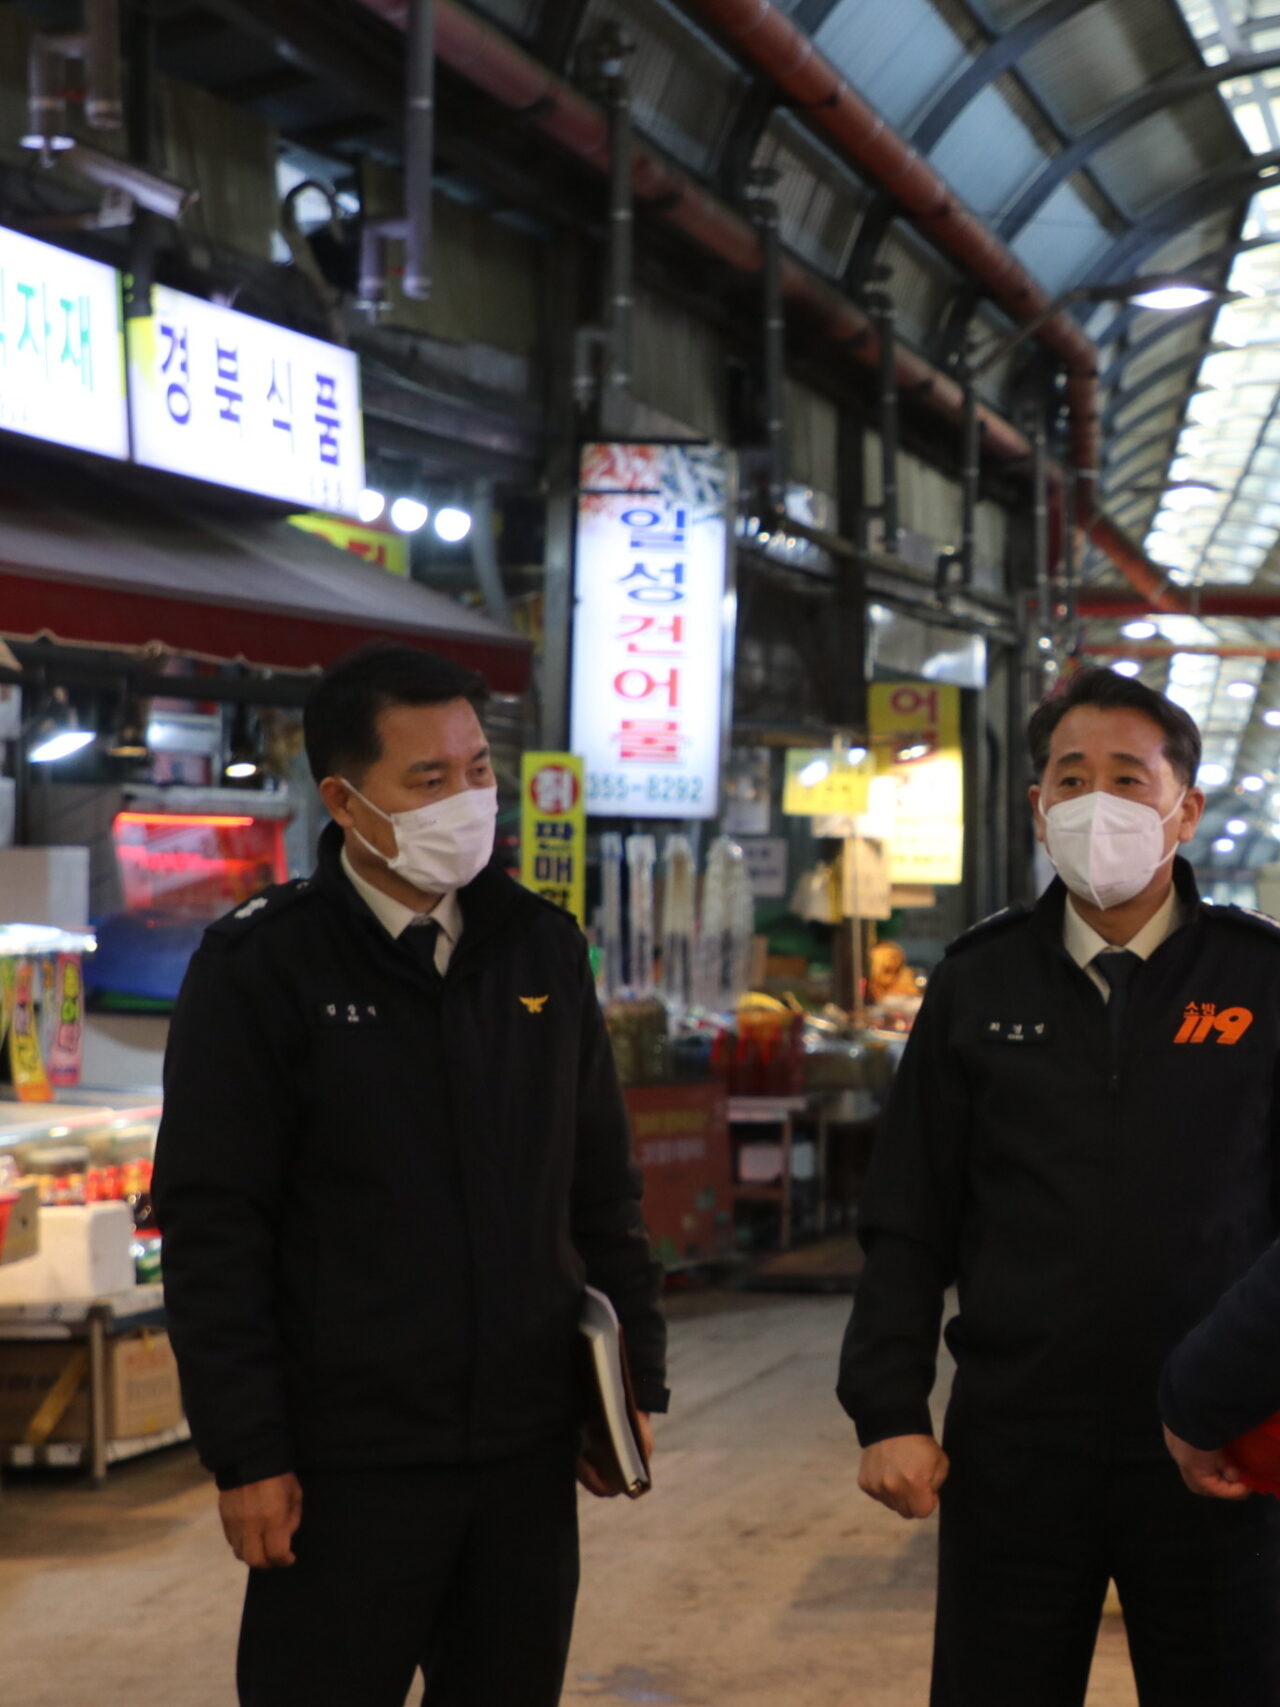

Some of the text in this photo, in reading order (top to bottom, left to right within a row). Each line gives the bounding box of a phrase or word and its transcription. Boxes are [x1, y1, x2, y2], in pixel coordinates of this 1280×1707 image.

[160, 324, 343, 467] 경북식품
[1173, 1006, 1254, 1045] 119
[1184, 1001, 1216, 1017] 소방
